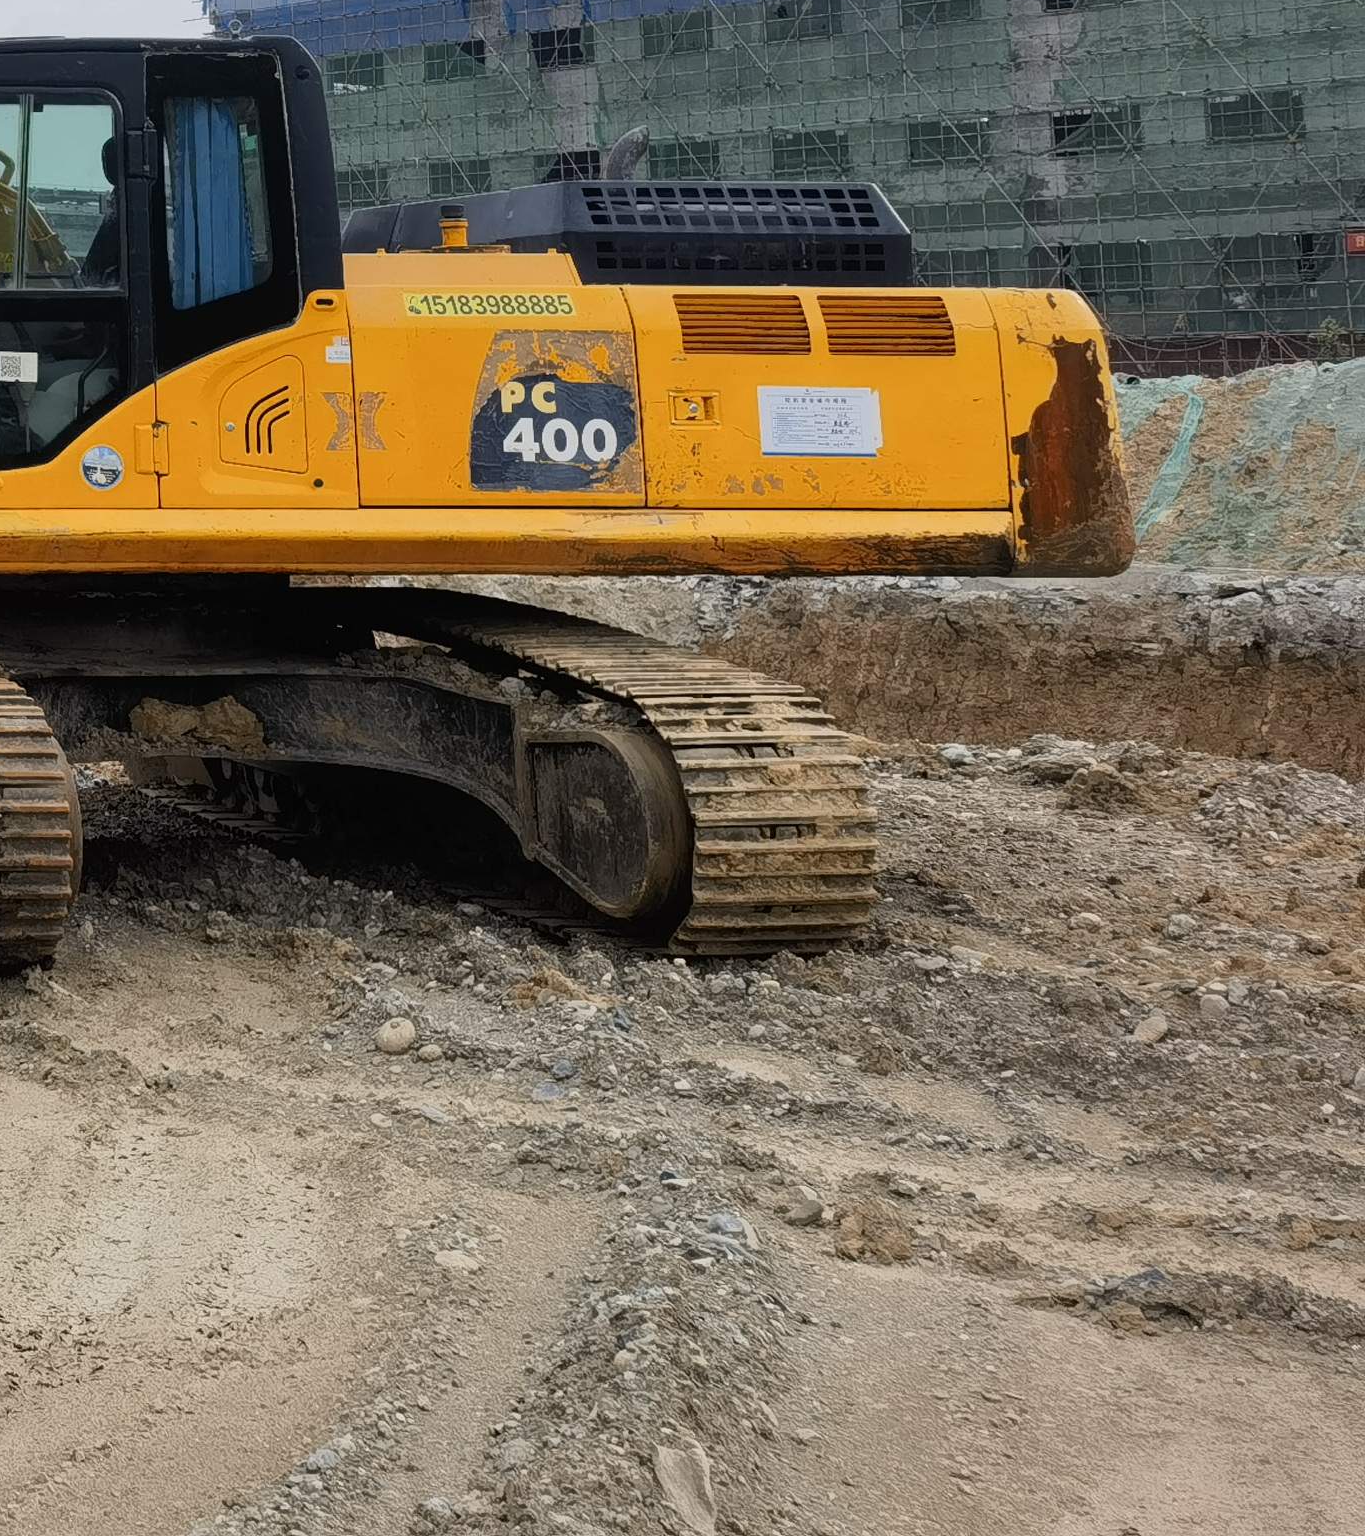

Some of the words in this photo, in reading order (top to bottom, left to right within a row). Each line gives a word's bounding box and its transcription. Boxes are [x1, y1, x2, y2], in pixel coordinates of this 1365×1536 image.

[420, 294, 573, 315] 15183988885
[500, 381, 557, 414] PC
[502, 417, 618, 462] 400
